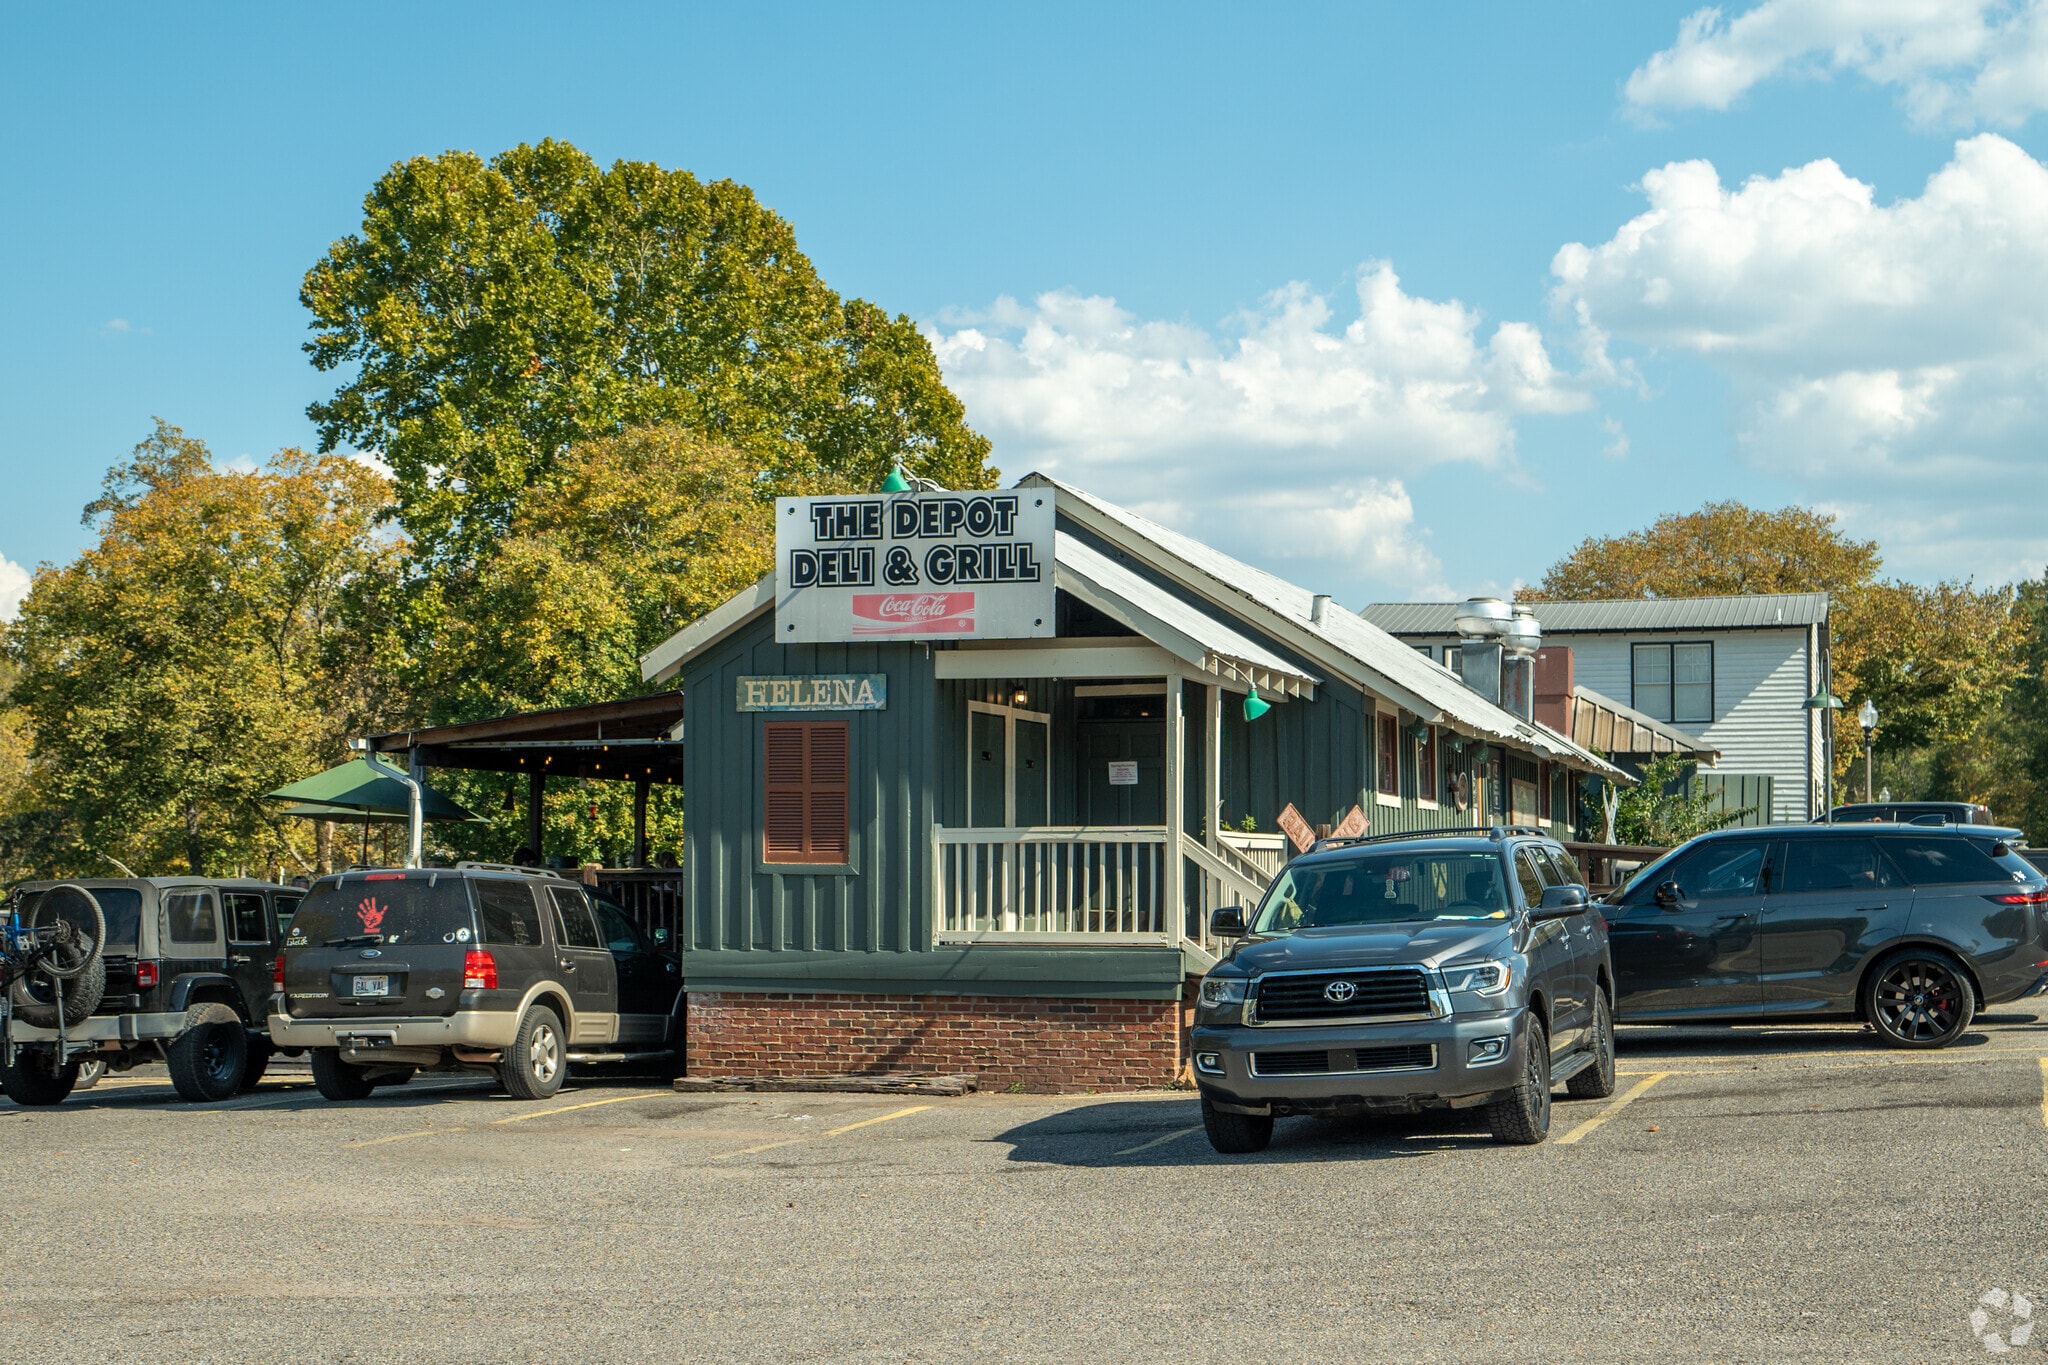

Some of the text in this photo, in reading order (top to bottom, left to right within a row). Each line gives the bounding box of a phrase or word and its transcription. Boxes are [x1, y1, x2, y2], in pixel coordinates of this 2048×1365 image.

[810, 496, 1018, 541] THE DEPOT
[790, 543, 1041, 588] DELI & GRILL
[879, 595, 949, 617] Coca-Cola
[745, 679, 877, 707] HELENA
